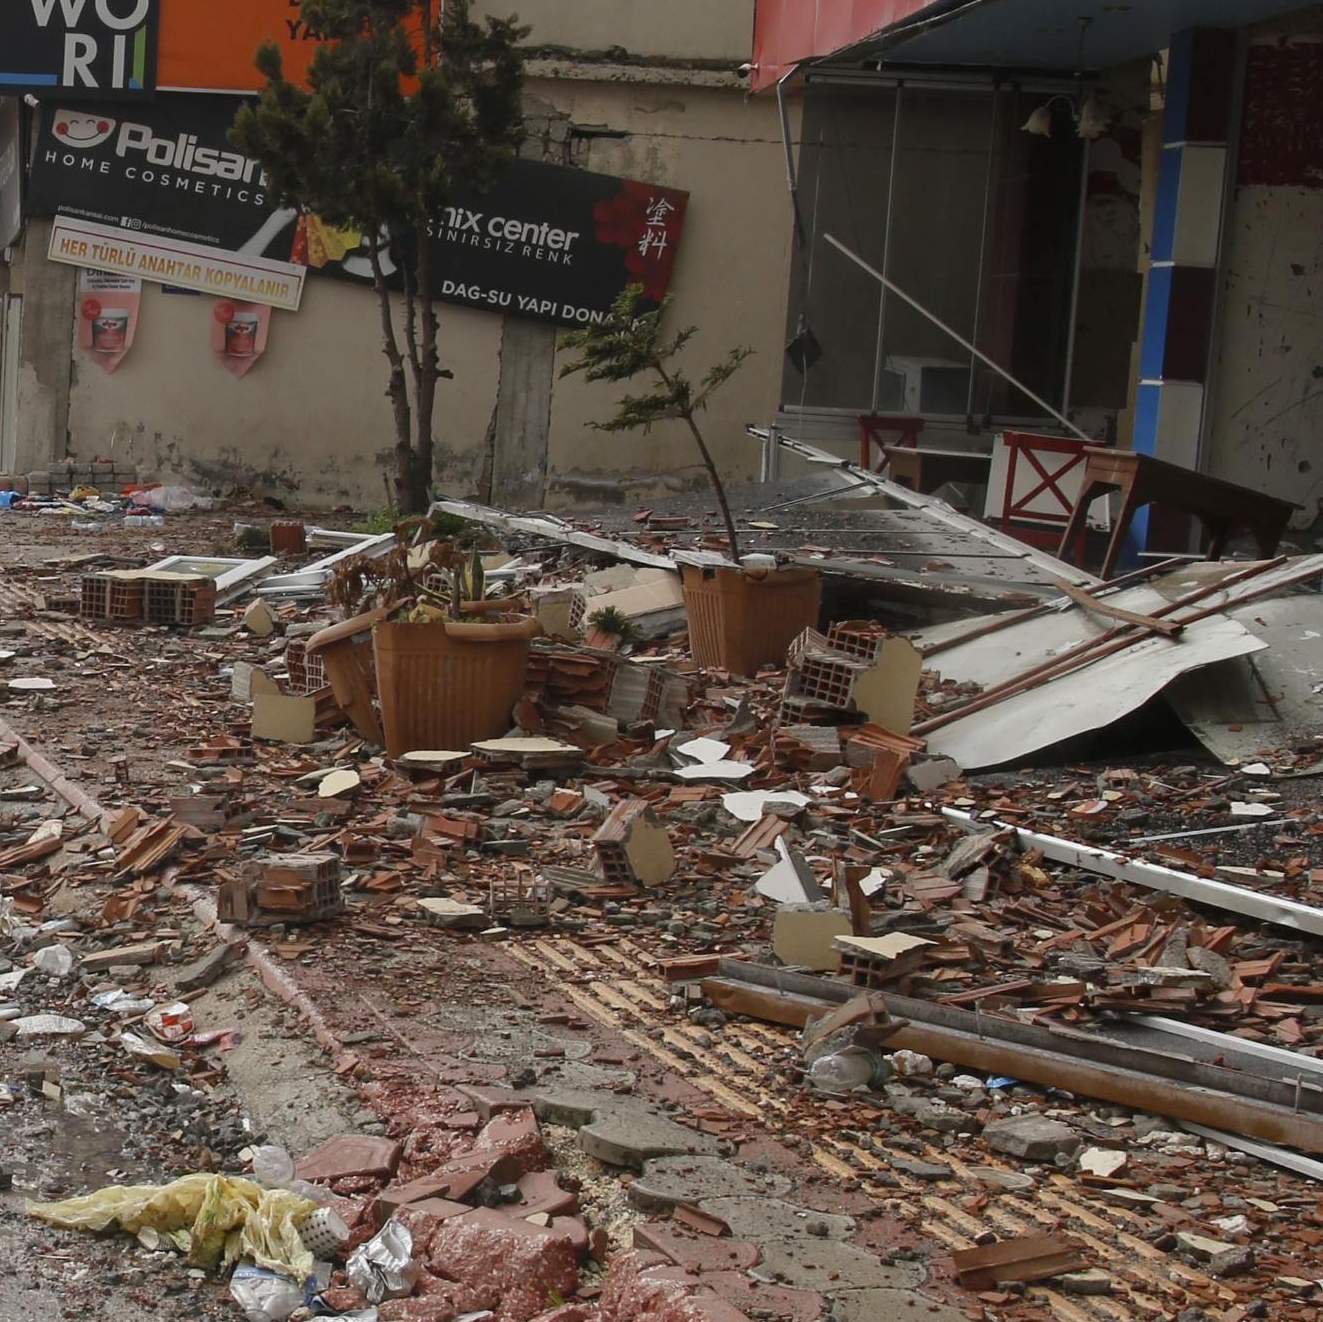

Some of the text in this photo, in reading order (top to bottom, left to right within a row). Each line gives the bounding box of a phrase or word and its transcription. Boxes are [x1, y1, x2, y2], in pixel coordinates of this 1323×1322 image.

[63, 33, 126, 89] RI
[45, 150, 110, 175] HOME
[125, 166, 264, 206] COSMETICS
[426, 226, 573, 266] SINIRSIZ RENK
[488, 217, 580, 251] center
[60, 238, 88, 257] HER
[92, 241, 136, 267] TÜRLÜ
[138, 254, 202, 281] ANAHTAR
[205, 268, 290, 298] KOPYALANIR
[517, 295, 557, 316] YAPI
